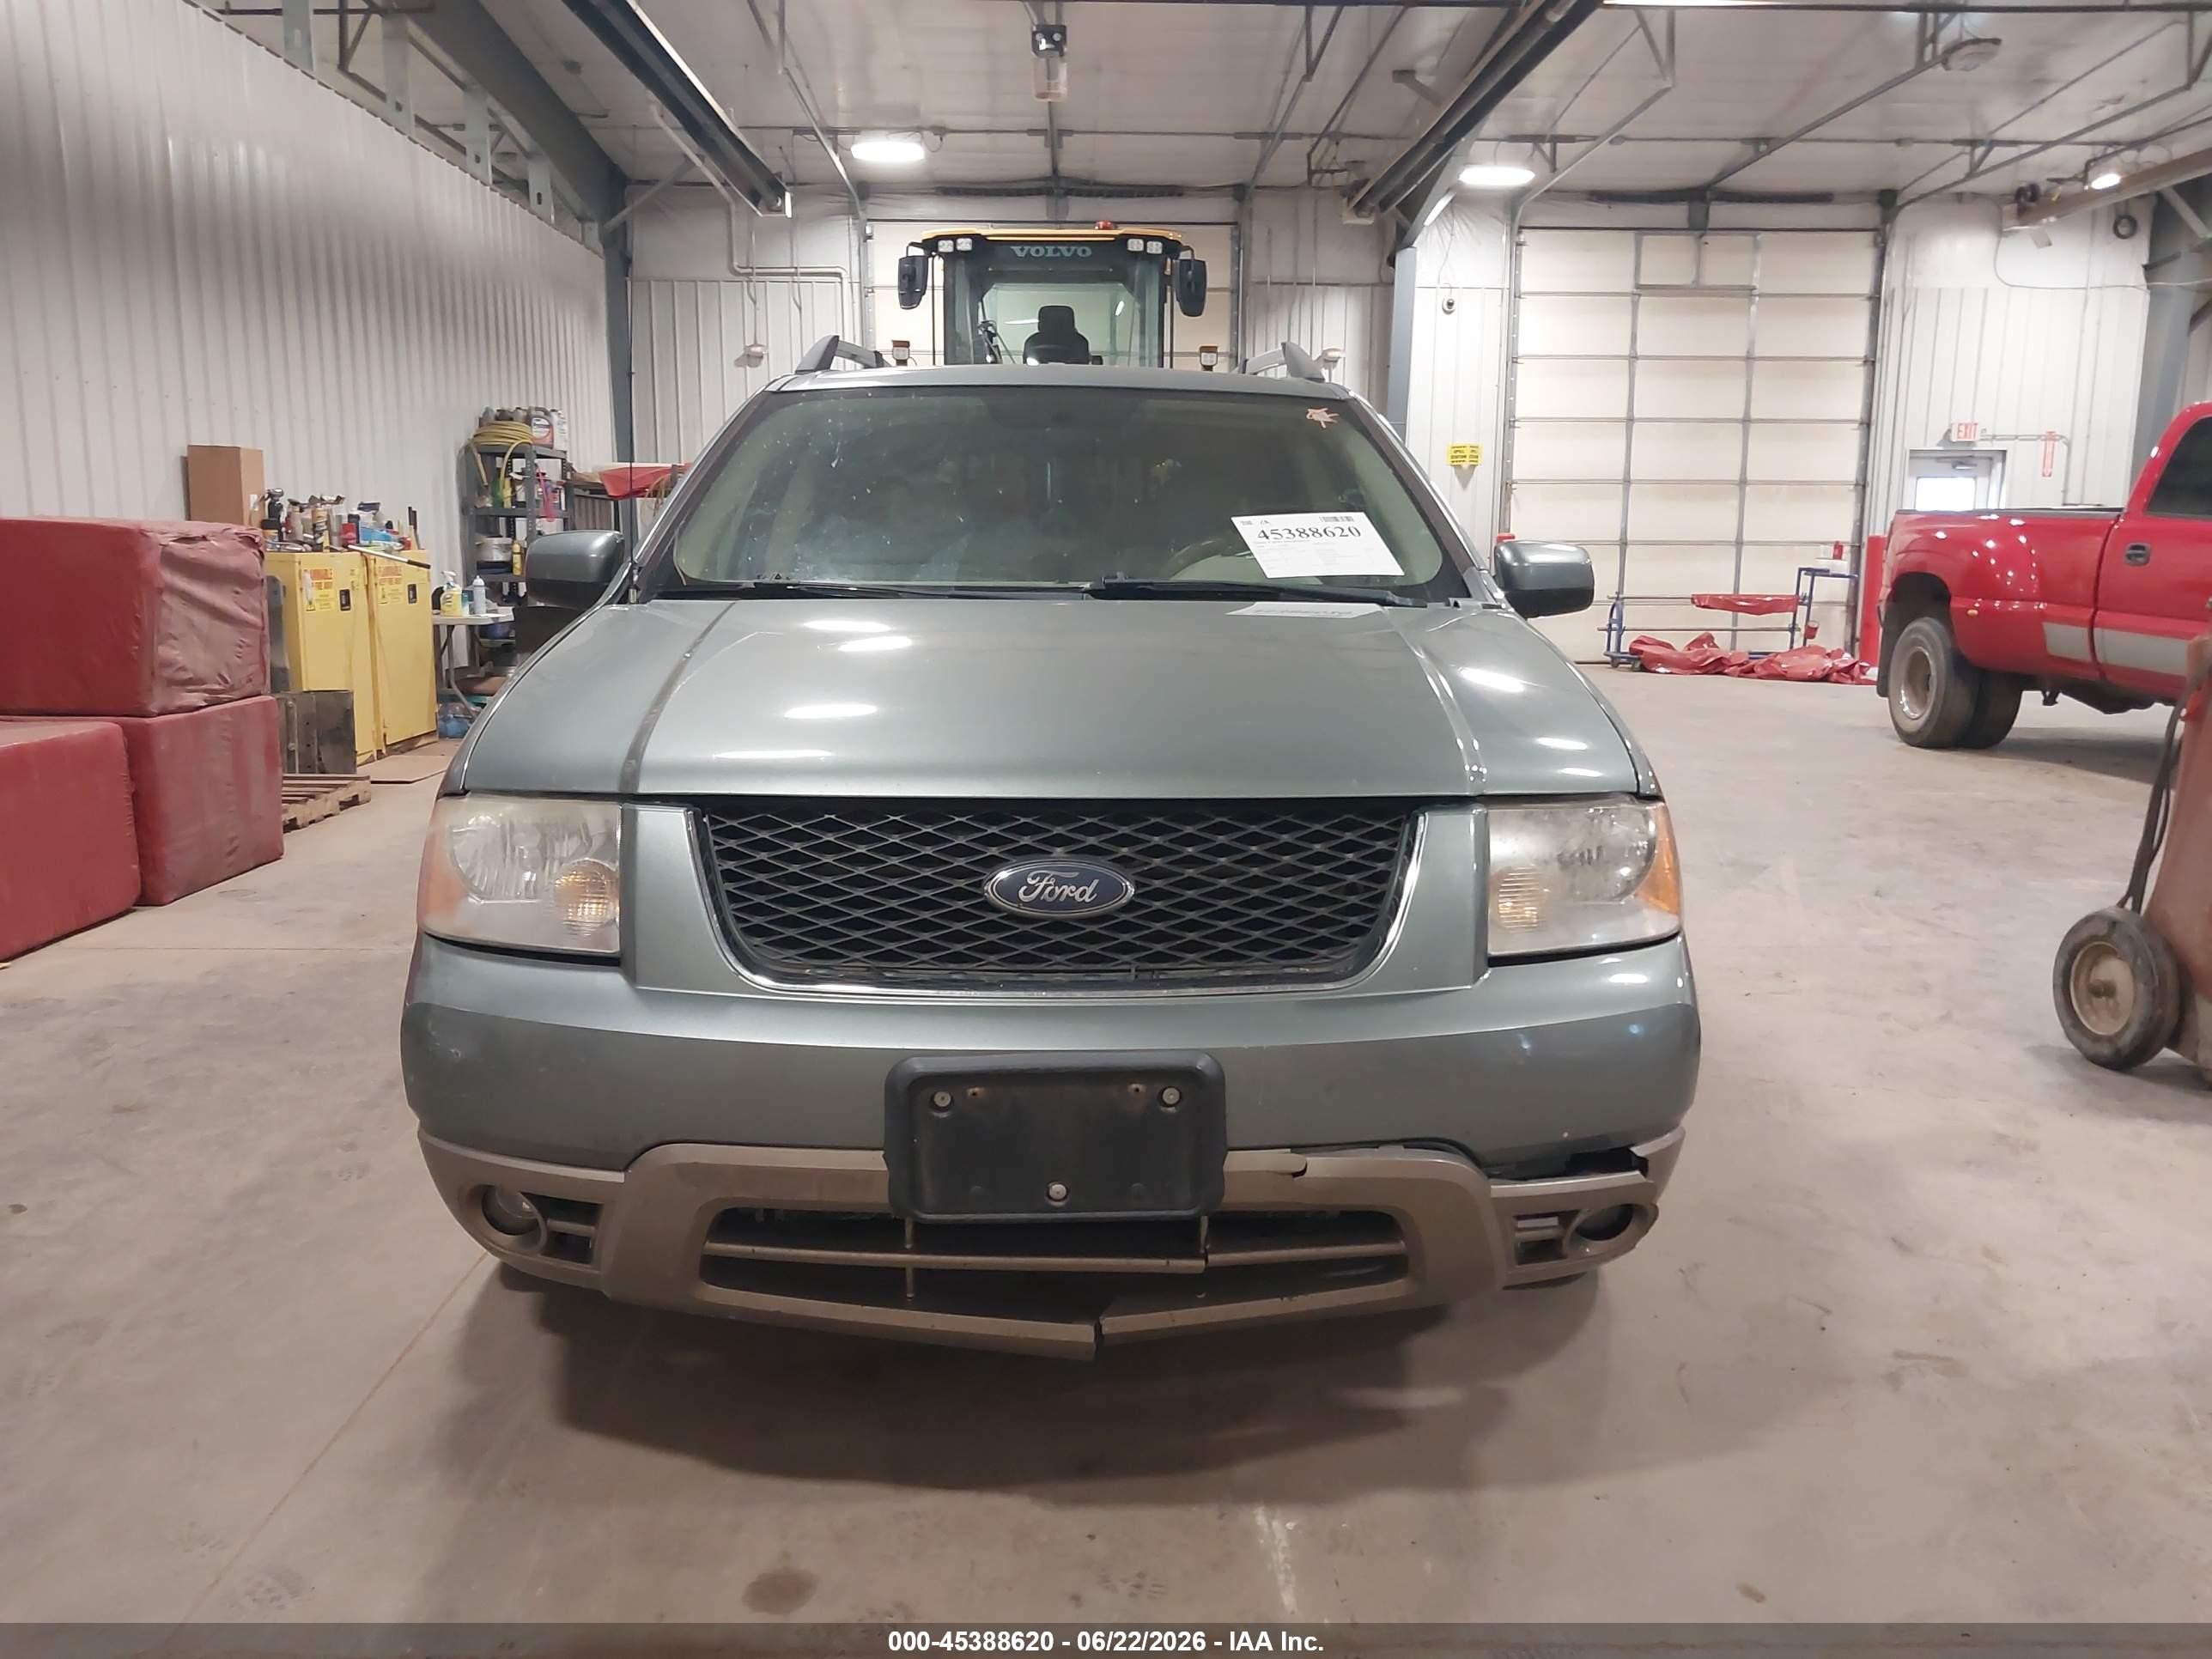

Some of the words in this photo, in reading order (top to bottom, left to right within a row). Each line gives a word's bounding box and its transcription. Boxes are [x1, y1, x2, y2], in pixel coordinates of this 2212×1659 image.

[1010, 245, 1093, 258] VOLVO
[1957, 422, 1978, 441] EXIT
[1257, 526, 1361, 539] 45388620
[1018, 870, 1099, 902] Ford
